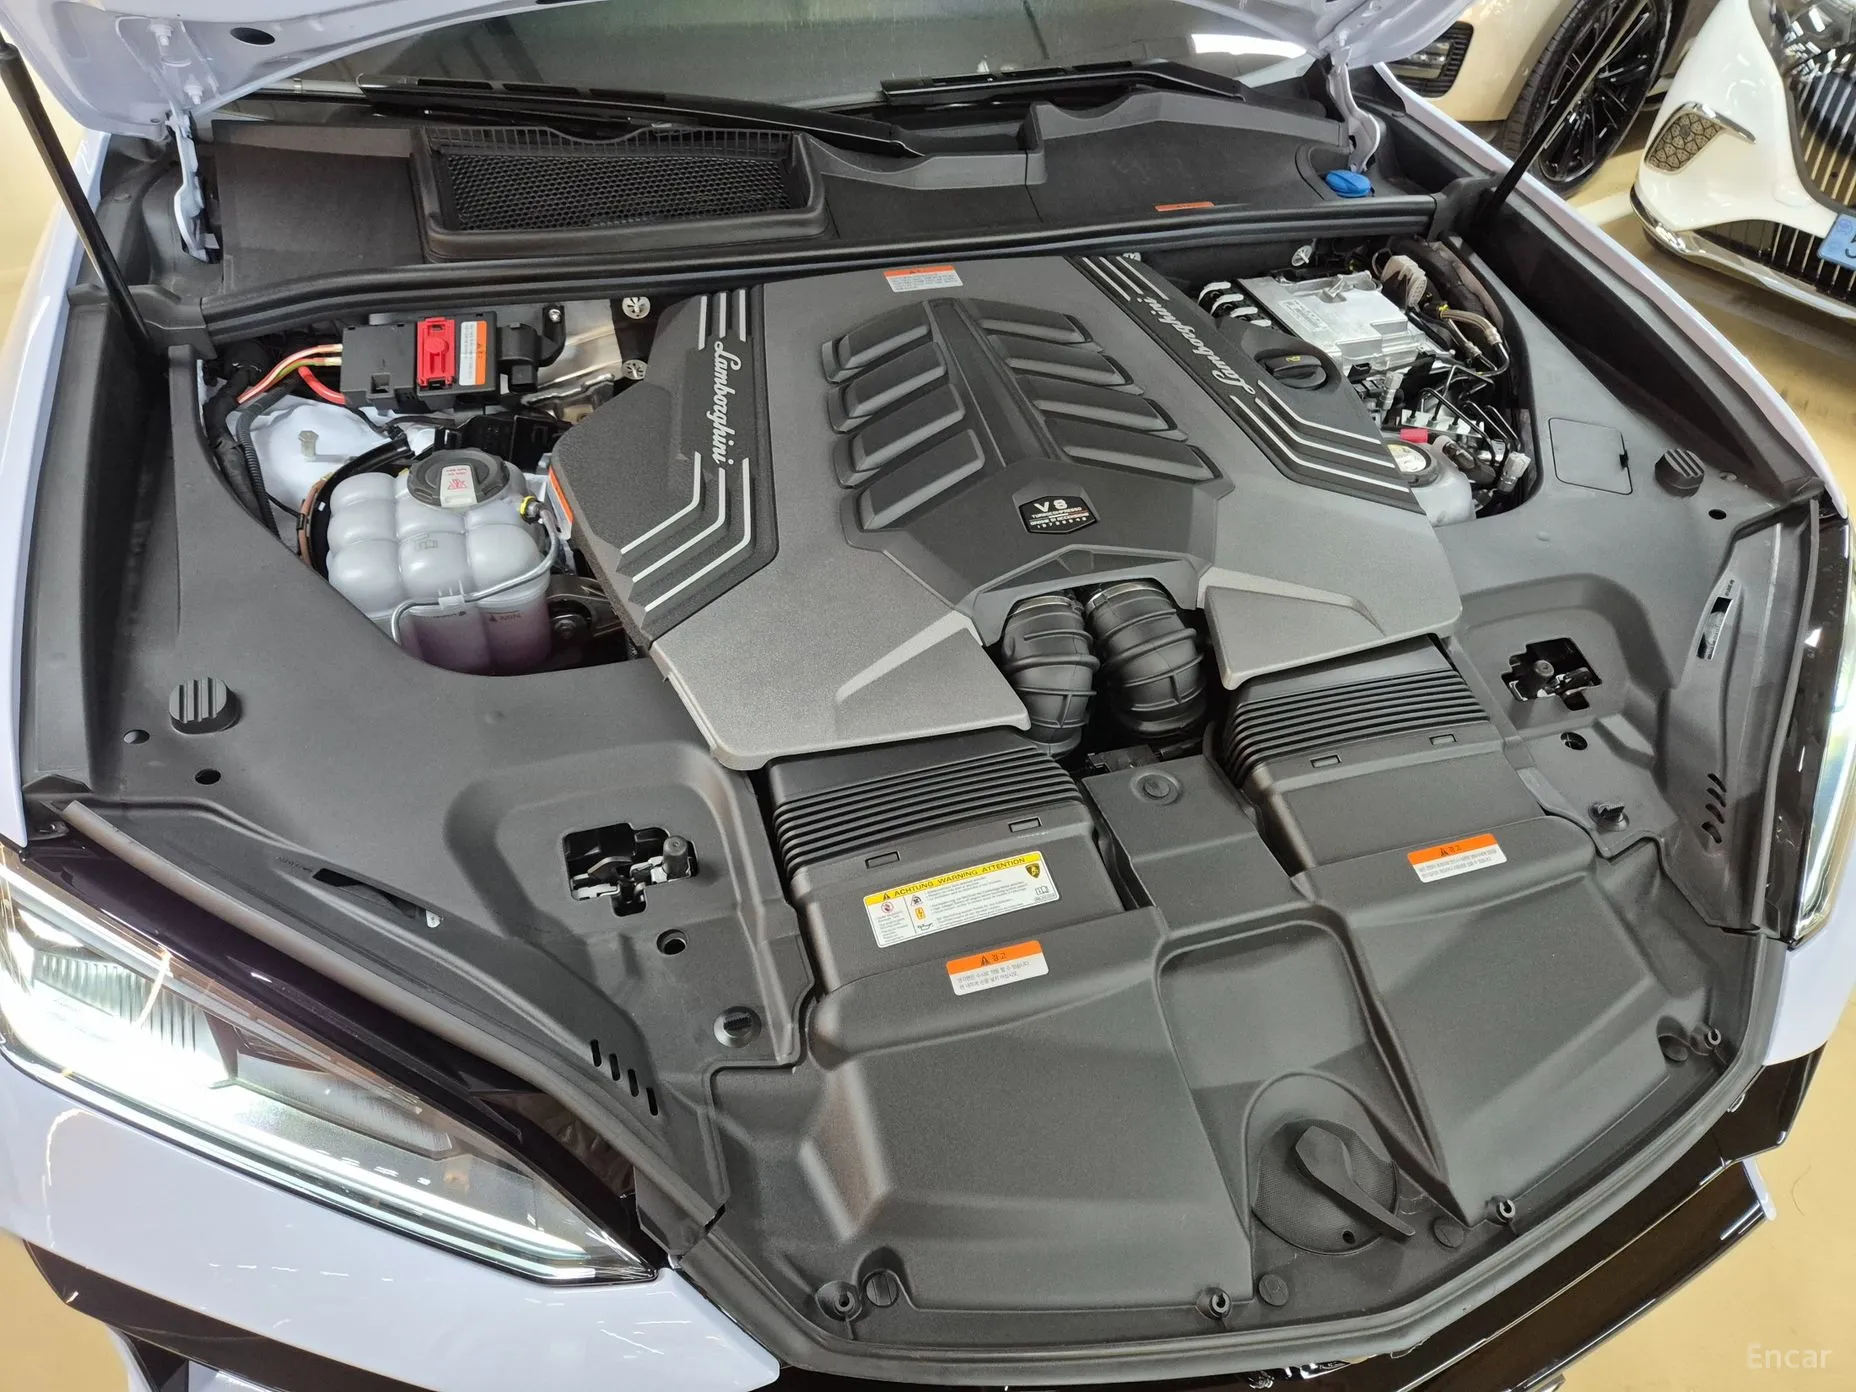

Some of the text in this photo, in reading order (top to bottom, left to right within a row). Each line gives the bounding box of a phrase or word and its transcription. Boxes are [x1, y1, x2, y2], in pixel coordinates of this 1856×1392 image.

[1137, 297, 1256, 394] Lamborghini
[706, 341, 742, 464] Lamborghini
[1033, 499, 1068, 513] V8
[894, 857, 1026, 897] ACHTUNG WARNING ATTENTION
